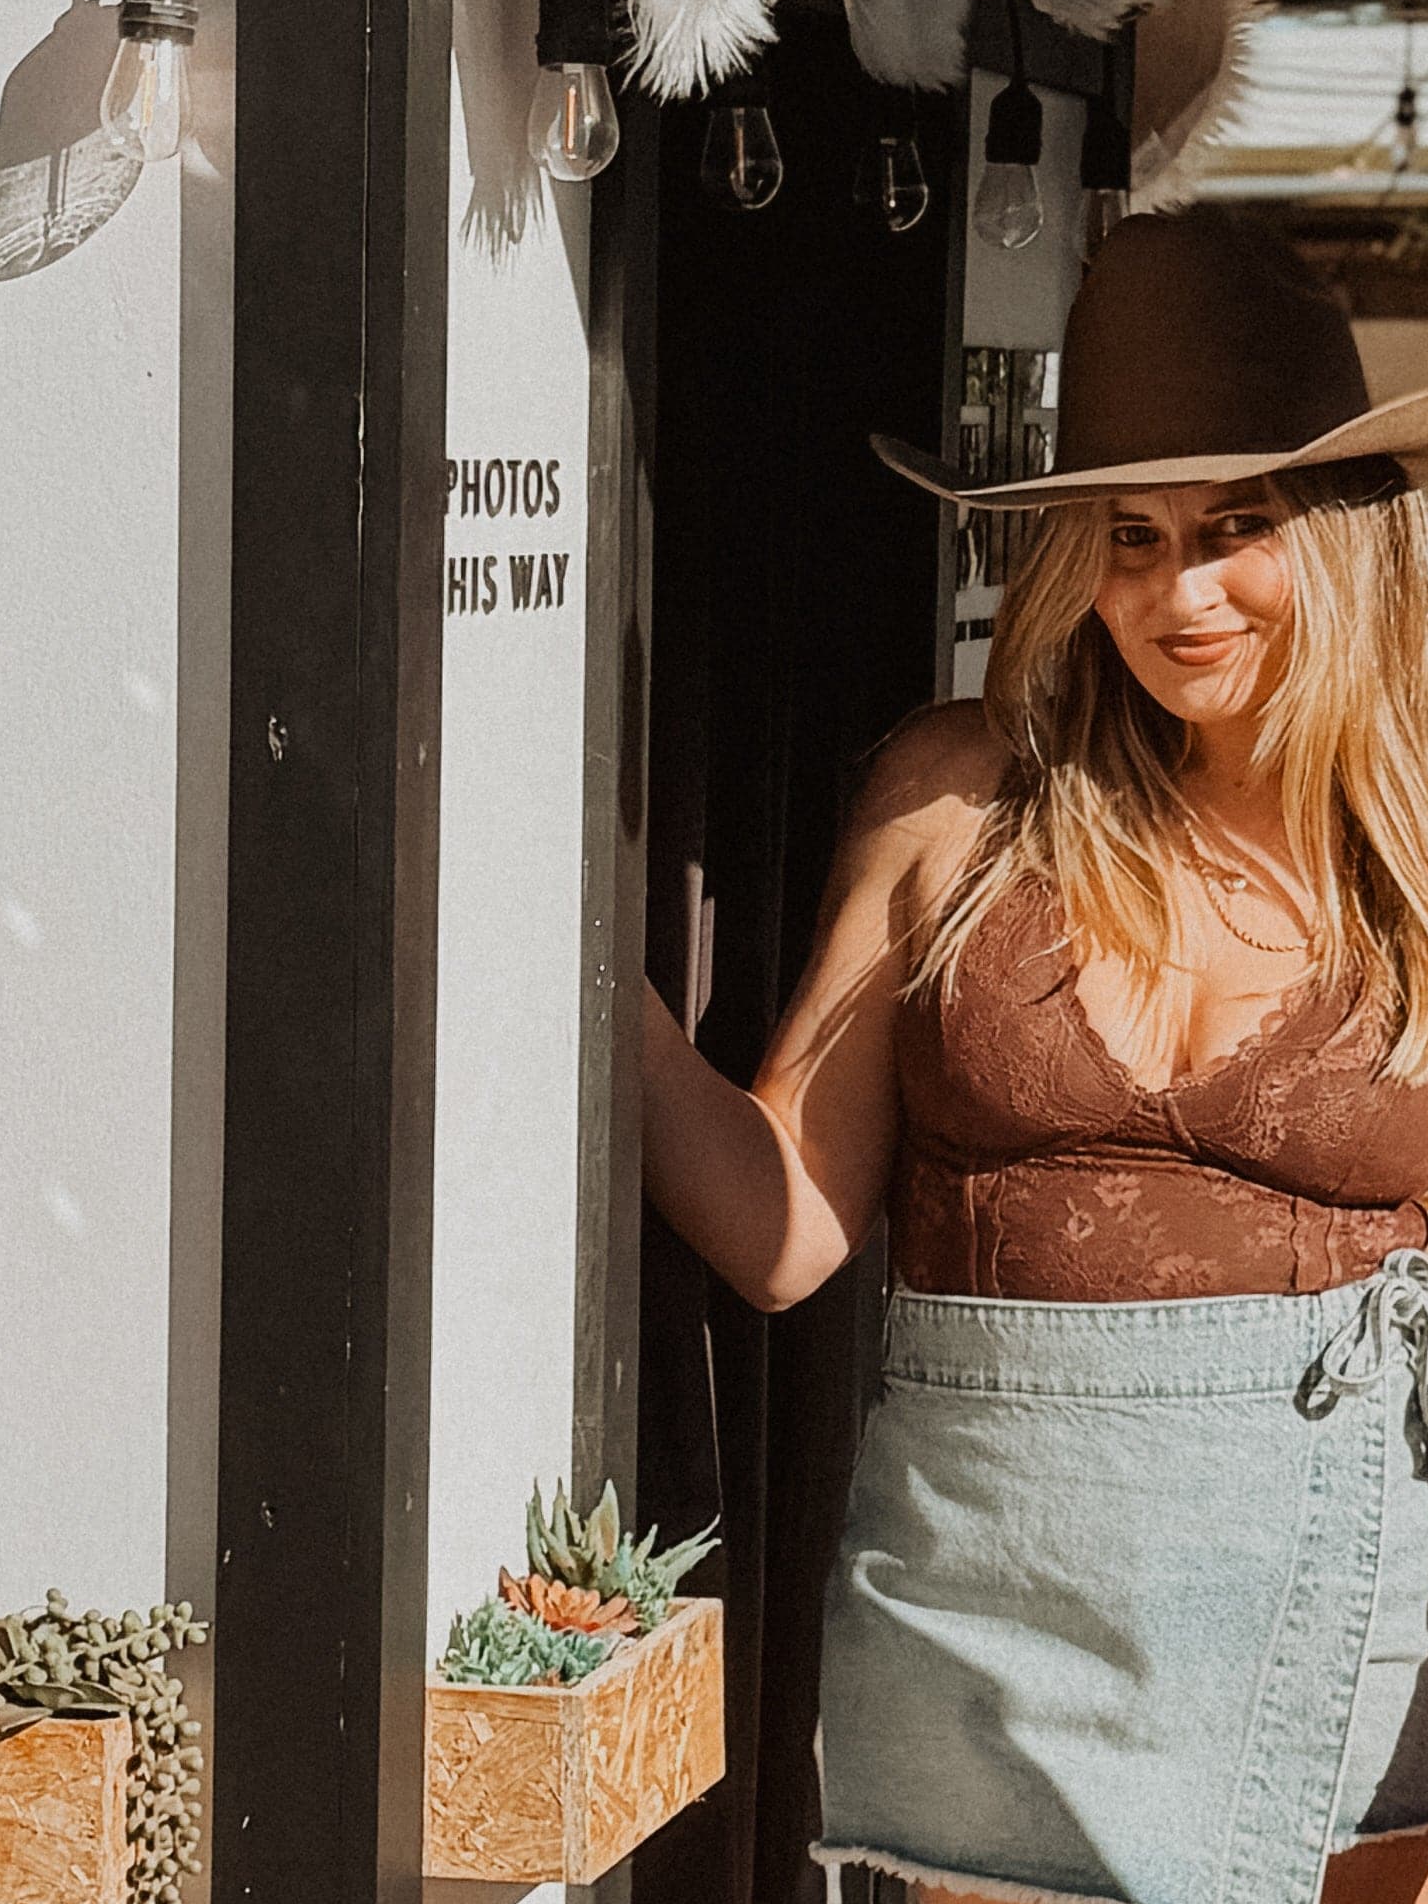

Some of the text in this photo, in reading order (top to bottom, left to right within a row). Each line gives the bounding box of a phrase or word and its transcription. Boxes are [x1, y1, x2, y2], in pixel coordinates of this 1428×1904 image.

[445, 458, 560, 518] PHOTOS
[447, 553, 570, 616] HIS WAY
